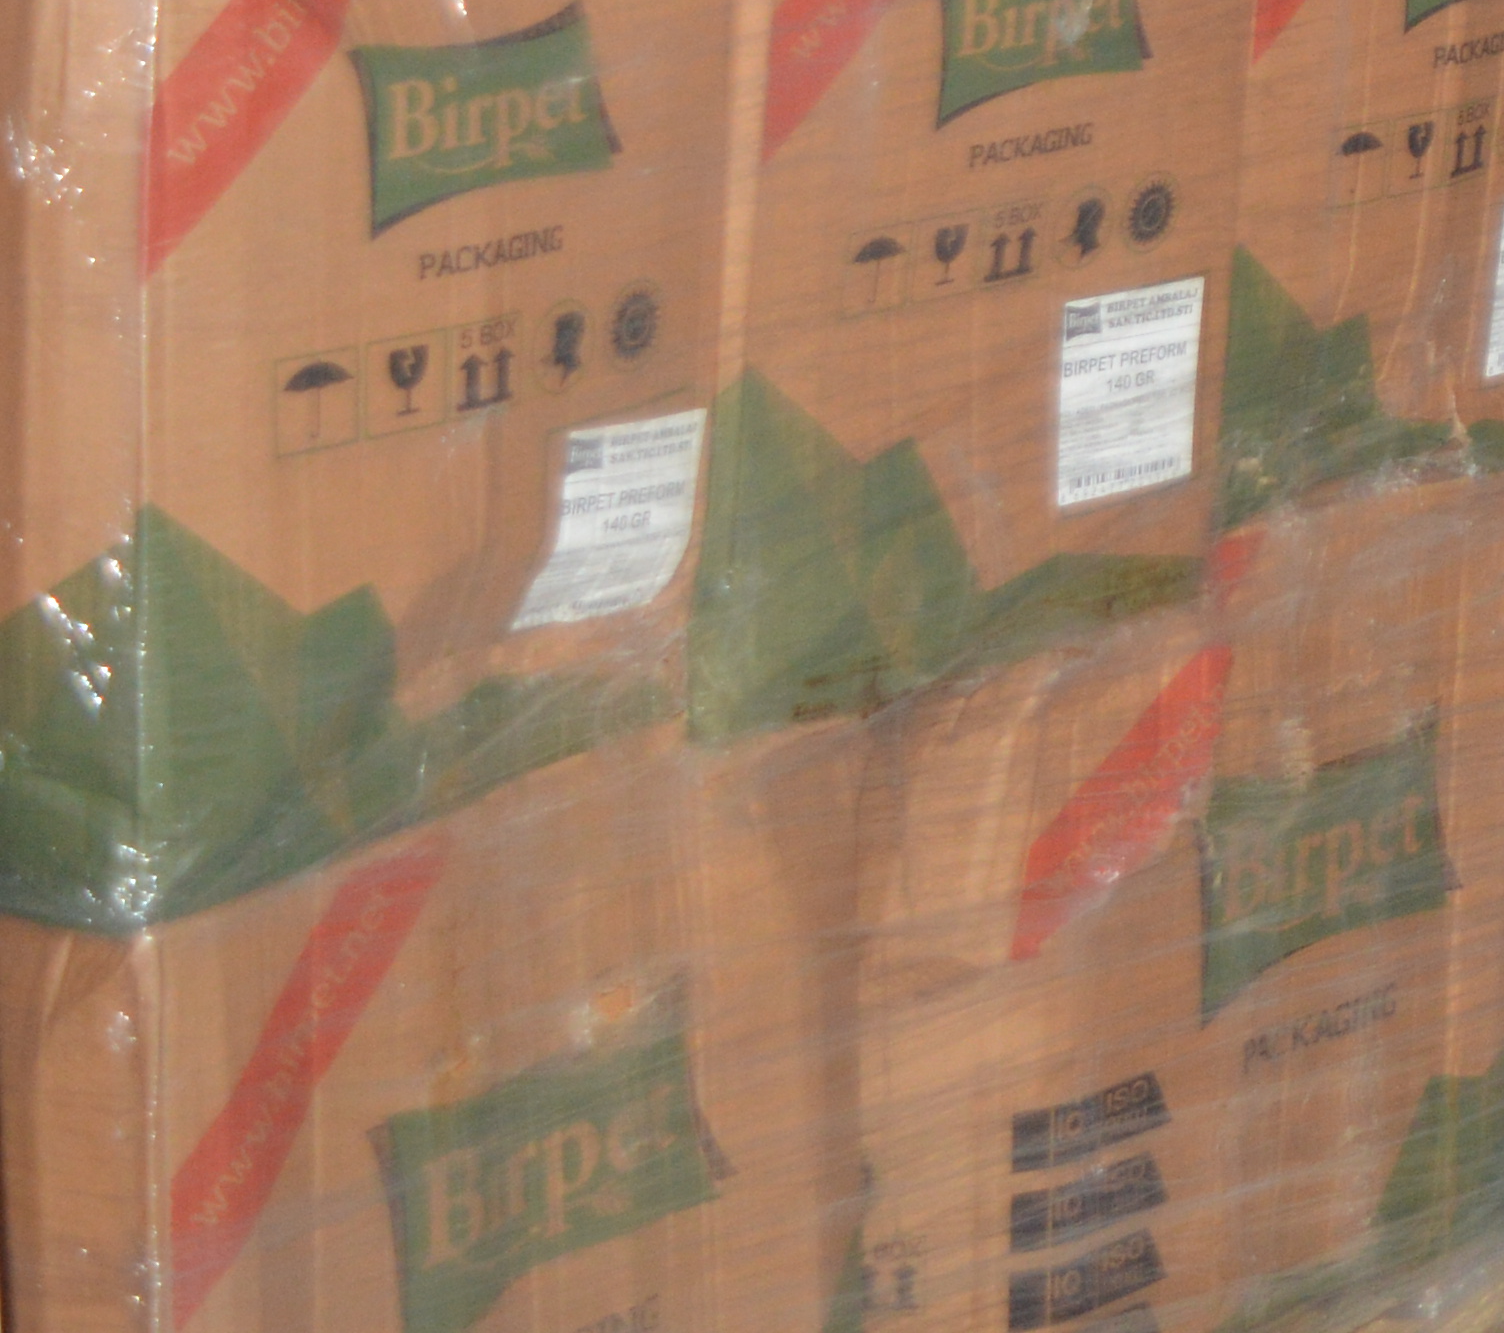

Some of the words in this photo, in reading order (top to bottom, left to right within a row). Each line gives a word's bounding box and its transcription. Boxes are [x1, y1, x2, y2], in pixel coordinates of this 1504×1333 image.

[388, 78, 586, 167] Birpet
[969, 122, 1094, 168] PACKAGING
[419, 225, 563, 280] PACKAGING
[1063, 354, 1116, 378] BIRPET
[1121, 341, 1187, 368] PREFORM
[1107, 376, 1131, 393] 140
[1135, 369, 1156, 388] GR
[562, 493, 615, 516] BIRPET
[619, 481, 685, 505] PREFORM
[603, 517, 627, 533] 140
[1108, 1079, 1149, 1112] ISO
